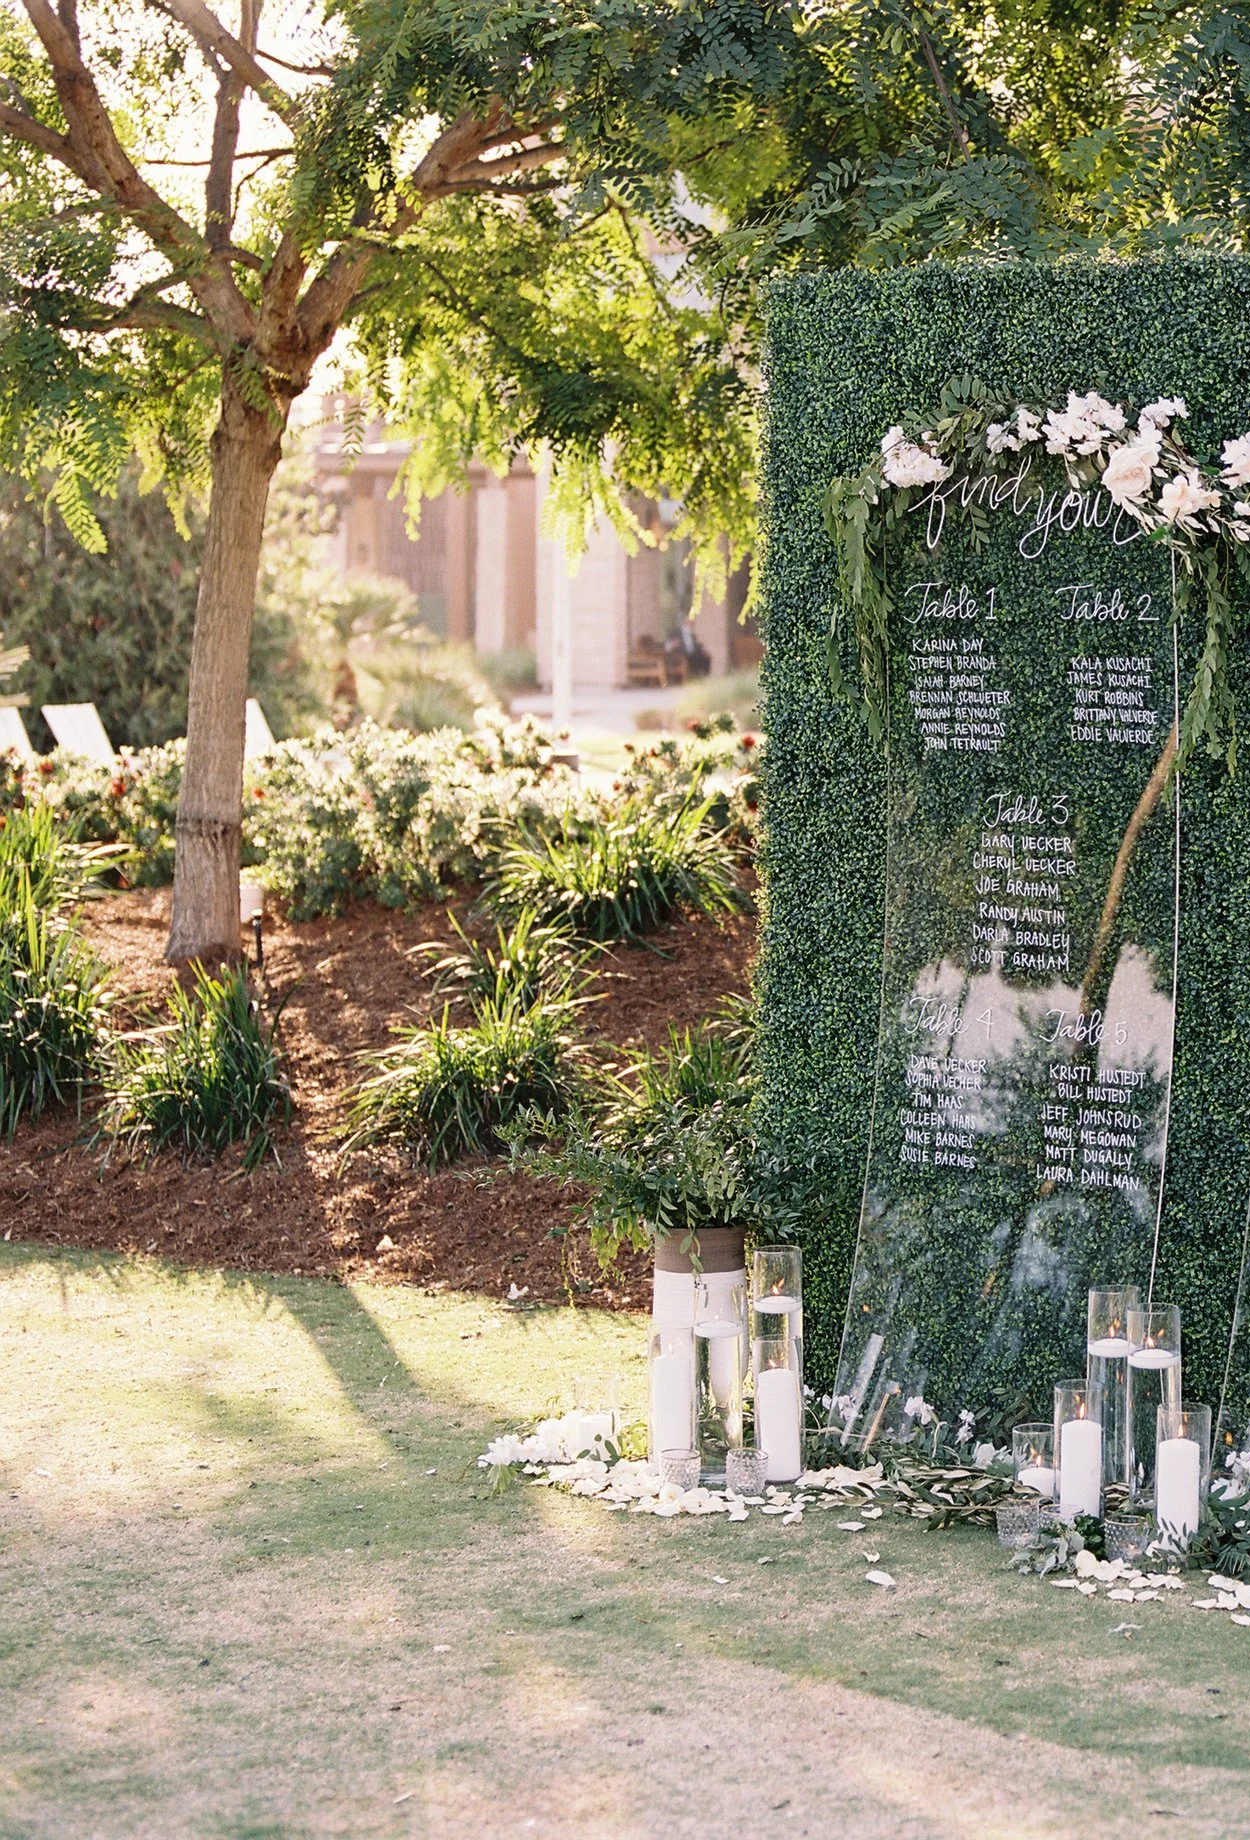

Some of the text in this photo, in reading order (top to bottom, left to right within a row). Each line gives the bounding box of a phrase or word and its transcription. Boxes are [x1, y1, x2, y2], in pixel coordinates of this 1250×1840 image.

[908, 455, 1032, 549] find
[903, 581, 997, 623] Table 1
[1054, 584, 1159, 621] Table 2
[912, 638, 984, 654] KARINA DAY
[908, 655, 997, 670] STEPHEN BRANDA
[1072, 656, 1153, 672] KALA KUSACHI
[949, 674, 984, 691] BARNEY
[1067, 671, 1152, 688] JAMES KUSACHI
[909, 691, 1010, 705] BRENNAN SCHLUETER
[1076, 689, 1143, 706] KURT ROBBINS
[915, 707, 1000, 722] MORGAN REYNOLDS
[1073, 707, 1158, 725] BRITTANY VALVERDE
[920, 722, 1006, 738] ANNIE REYNOLDS
[1071, 725, 1156, 744] EDDIE VALVERDE
[924, 737, 1000, 752] JOHN TETRAULT
[983, 791, 1069, 827] Table 3
[981, 832, 1072, 856] GARY UECKER
[973, 852, 1076, 876] CHERYL UECKER
[975, 875, 1059, 900] JOE GRAHAM
[980, 902, 1065, 927] RANDY AUSTIN
[973, 925, 1070, 953] DARLA BRADLEY
[971, 946, 1069, 971] SCOTT GRAHAM
[905, 997, 995, 1040] Table 4
[1039, 1009, 1128, 1045] Table 5
[911, 1054, 987, 1073] DAVE UECKER
[906, 1071, 939, 1088] SOPHIA
[1050, 1064, 1146, 1089] KRISTI HUSTEDT
[912, 1092, 963, 1109] TIM HAAS
[1058, 1083, 1132, 1104] BILL HUSTEDT
[900, 1109, 976, 1130] COLLEEN HAAS
[1041, 1103, 1141, 1129] JEFF JOHNSRUD
[905, 1129, 975, 1148] MIKE BARNES
[1044, 1125, 1136, 1148] MARY MEGOWAN
[900, 1146, 977, 1169] SUSIE BARNES
[1046, 1145, 1132, 1171] MATT DUGALLY
[1036, 1164, 1139, 1190] LAURA DAHLMAN
